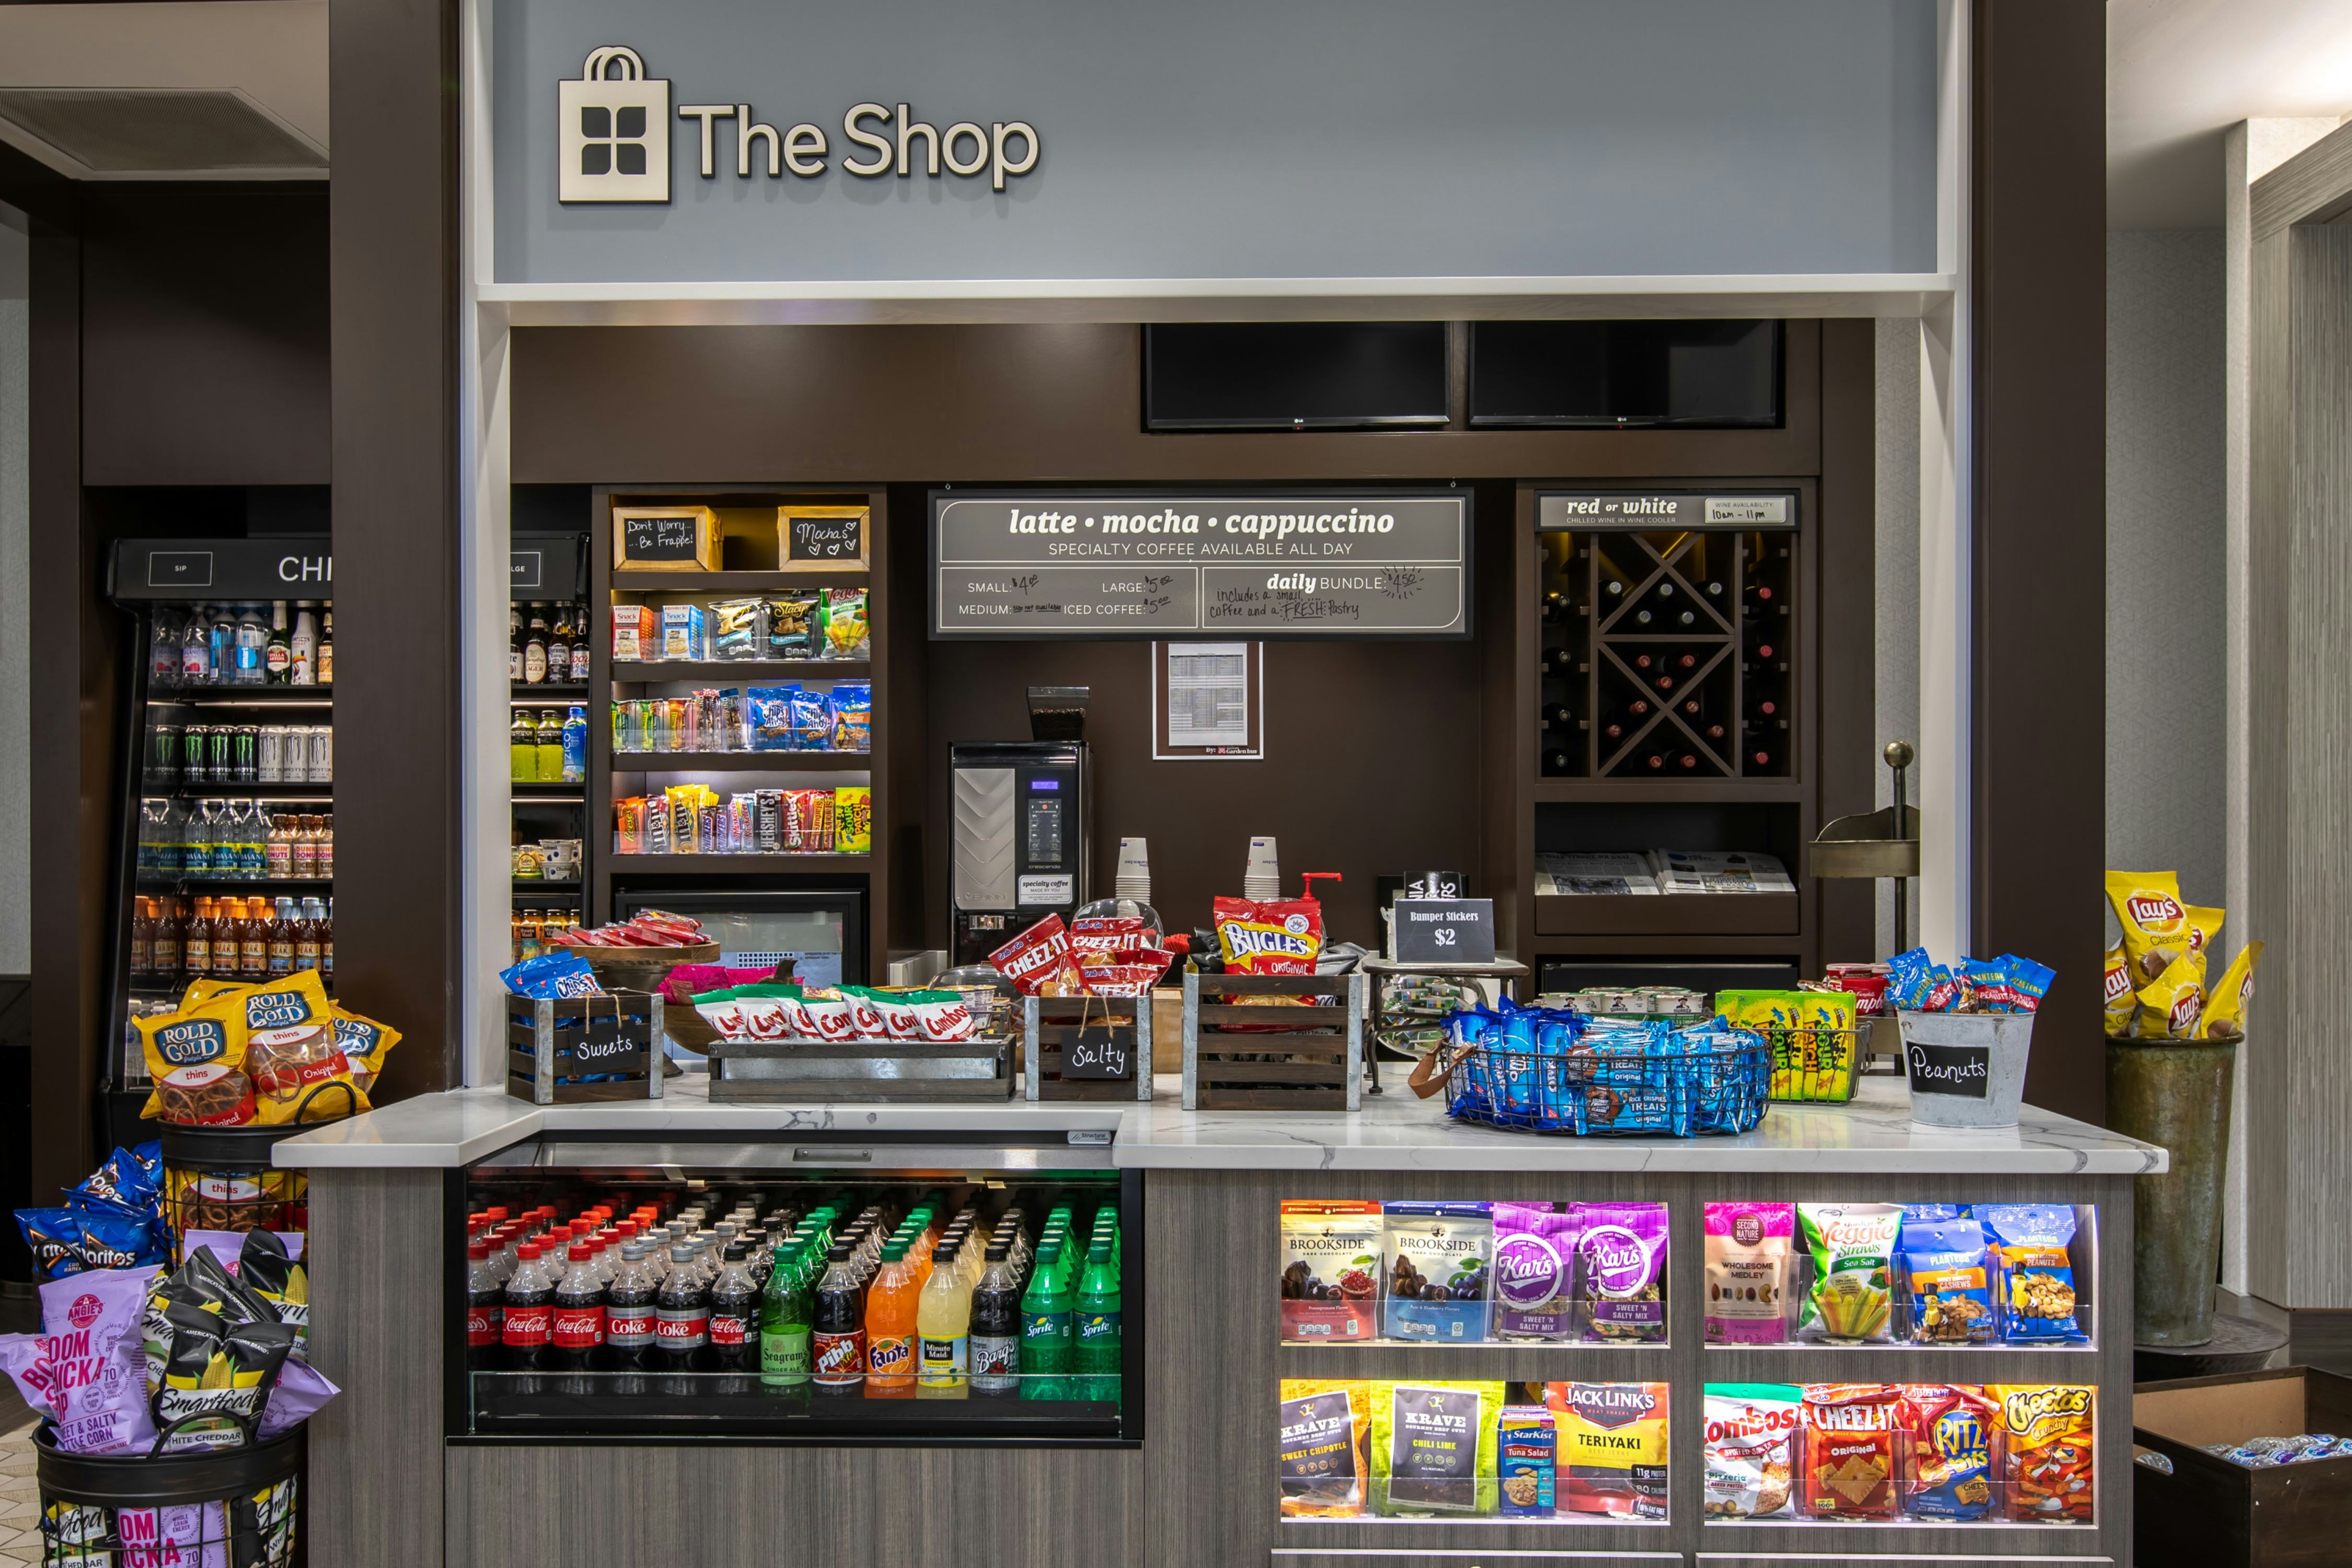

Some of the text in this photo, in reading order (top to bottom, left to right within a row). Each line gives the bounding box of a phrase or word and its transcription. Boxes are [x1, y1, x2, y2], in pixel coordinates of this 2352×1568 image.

[678, 102, 1041, 192] The Shop
[1567, 497, 1677, 514] red or white
[1009, 508, 1394, 539] latte mocha cappuccino
[658, 533, 694, 548] Frappe!
[1048, 543, 1353, 555] SPECIALTY COFFEE AVAILABLE ALL DAY
[968, 582, 1012, 593] SMALL:
[1102, 582, 1146, 593] LARGE:
[1267, 573, 1387, 594] daily BUNDLE:
[1217, 587, 1259, 602] includes
[959, 605, 1012, 615] MEDIUM:
[1064, 605, 1146, 615] ICED COFFEE:
[1209, 604, 1243, 618] coffee
[1248, 605, 1266, 617] and
[1283, 601, 1324, 617] FRESH
[1328, 599, 1359, 619] Pastry
[789, 794, 802, 847] Skittles
[845, 805, 854, 834] SOUR
[854, 803, 863, 835] PATCH
[1410, 910, 1479, 922] Bumper Stickers
[2131, 898, 2177, 923] Lay's
[1225, 923, 1307, 959] BUGLES
[1434, 928, 1456, 947] $2
[2150, 933, 2189, 947] Classic
[926, 1004, 968, 1036] Combos
[163, 1022, 215, 1044] ROLD
[165, 1037, 218, 1062] GOLD
[577, 1034, 633, 1060] Sweets
[1072, 1043, 1125, 1075] Salty
[1910, 1046, 1986, 1083] Peanuts
[186, 1068, 208, 1081] thins
[303, 1062, 338, 1080] Original
[1631, 1103, 1667, 1112] TREATS
[1736, 1220, 1759, 1229] SECOND
[1736, 1230, 1759, 1240] NATURE
[1816, 1220, 1895, 1248] Veggie
[1290, 1239, 1365, 1251] BROOKSIDE
[1400, 1237, 1475, 1251] BROOKSIDE
[1837, 1243, 1881, 1258] Straws
[1498, 1254, 1553, 1280] Kar's
[1843, 1260, 1858, 1268] Sea
[1939, 1281, 1971, 1290] CASHEWS
[67, 1302, 104, 1321] ANGIE'S
[506, 1316, 548, 1332] Coca-Cola
[611, 1319, 646, 1334] Coke
[1027, 1322, 1054, 1336] Sprite
[764, 1348, 809, 1364] Seagram's
[817, 1339, 854, 1374] Pibb
[976, 1339, 1016, 1374] Barq's
[160, 1386, 259, 1413] Smartfood
[1565, 1387, 1655, 1409] JACK LINK'S
[2008, 1388, 2090, 1434] Cheetos
[1405, 1412, 1467, 1427] KRAVE
[78, 1422, 85, 1434] &
[87, 1427, 113, 1445] CORN
[1513, 1430, 1553, 1439] StarKist
[2032, 1417, 2068, 1441] Crunchy
[194, 1432, 241, 1442] CHEDDAR
[1413, 1439, 1457, 1450] CHILI LIME
[1578, 1434, 1641, 1449] TERIYAKI
[1934, 1418, 1985, 1456] RITZ
[1281, 1442, 1346, 1461] SWEET CHIPOTLE
[1527, 1448, 1549, 1457] Salad
[1947, 1450, 1989, 1473] bits
[1636, 1468, 1650, 1478] 11g
[1709, 1472, 1747, 1481] Pizzeria
[172, 1514, 189, 1522] WHOLE
[1656, 1507, 1665, 1515] FREE
[172, 1524, 191, 1533] ENERGY
